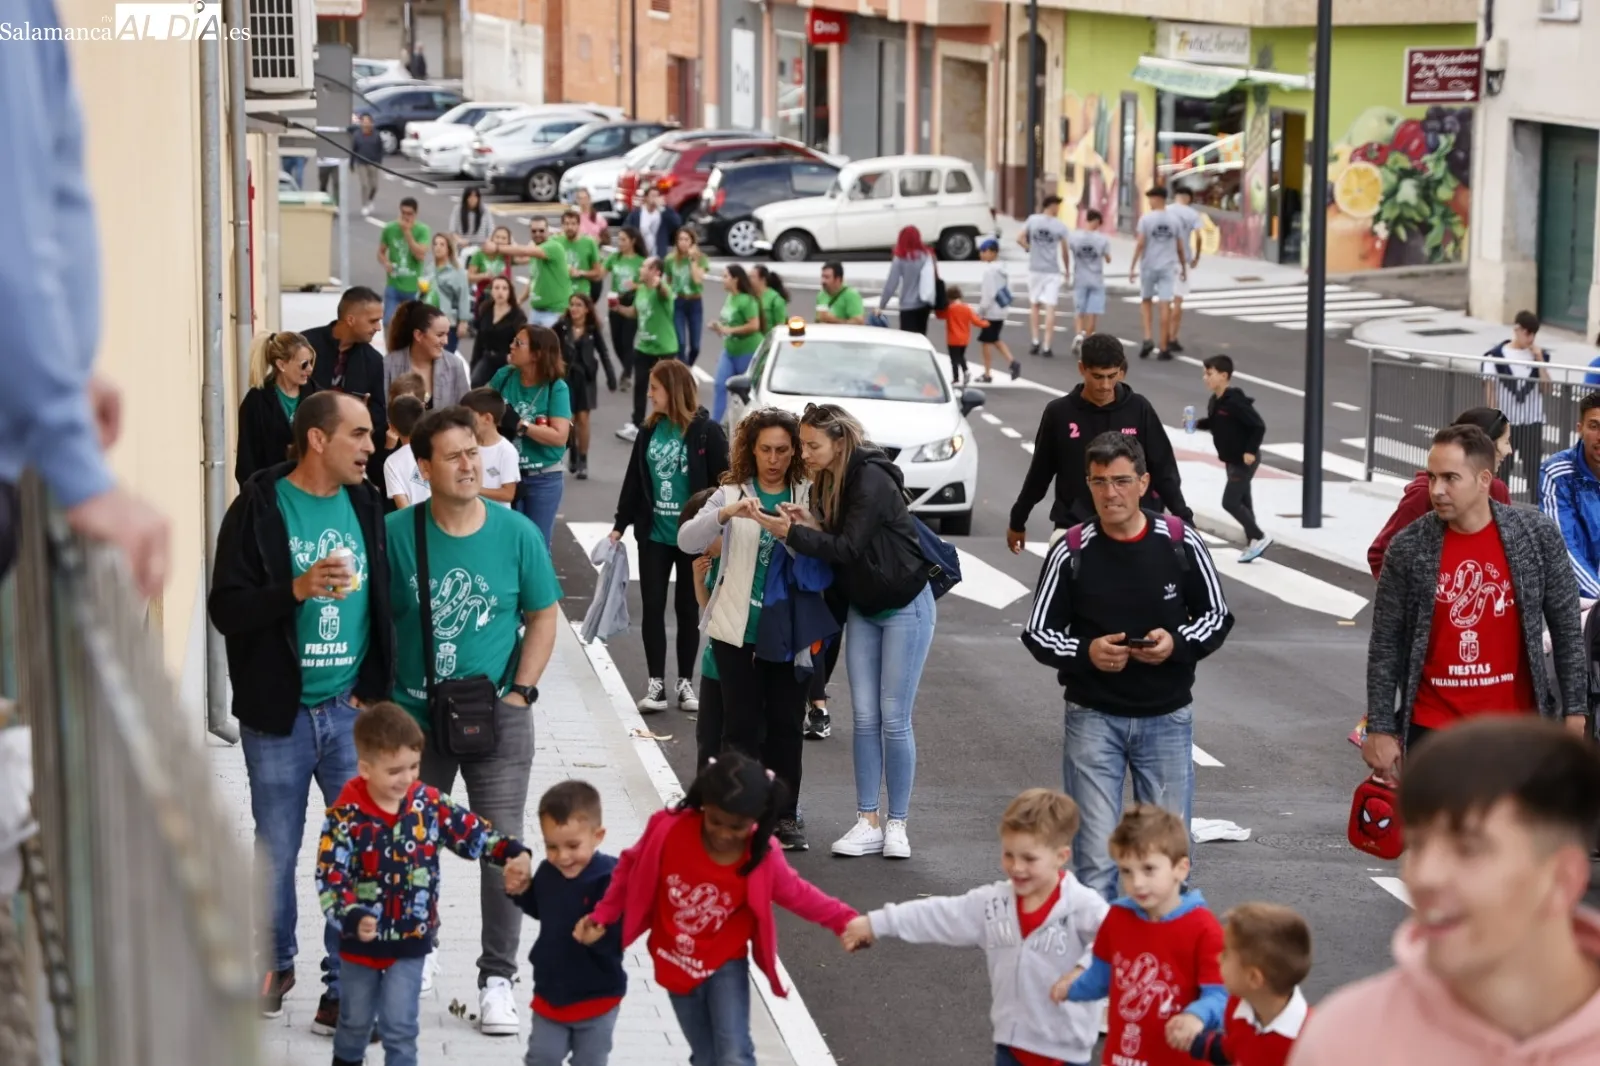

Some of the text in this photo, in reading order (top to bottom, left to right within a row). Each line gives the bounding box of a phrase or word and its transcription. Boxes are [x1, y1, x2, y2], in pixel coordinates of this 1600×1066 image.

[1069, 423, 1080, 438] 2
[304, 642, 347, 655] FIESTAS
[1448, 663, 1491, 675] FIESTAS
[1469, 678, 1478, 687] LA
